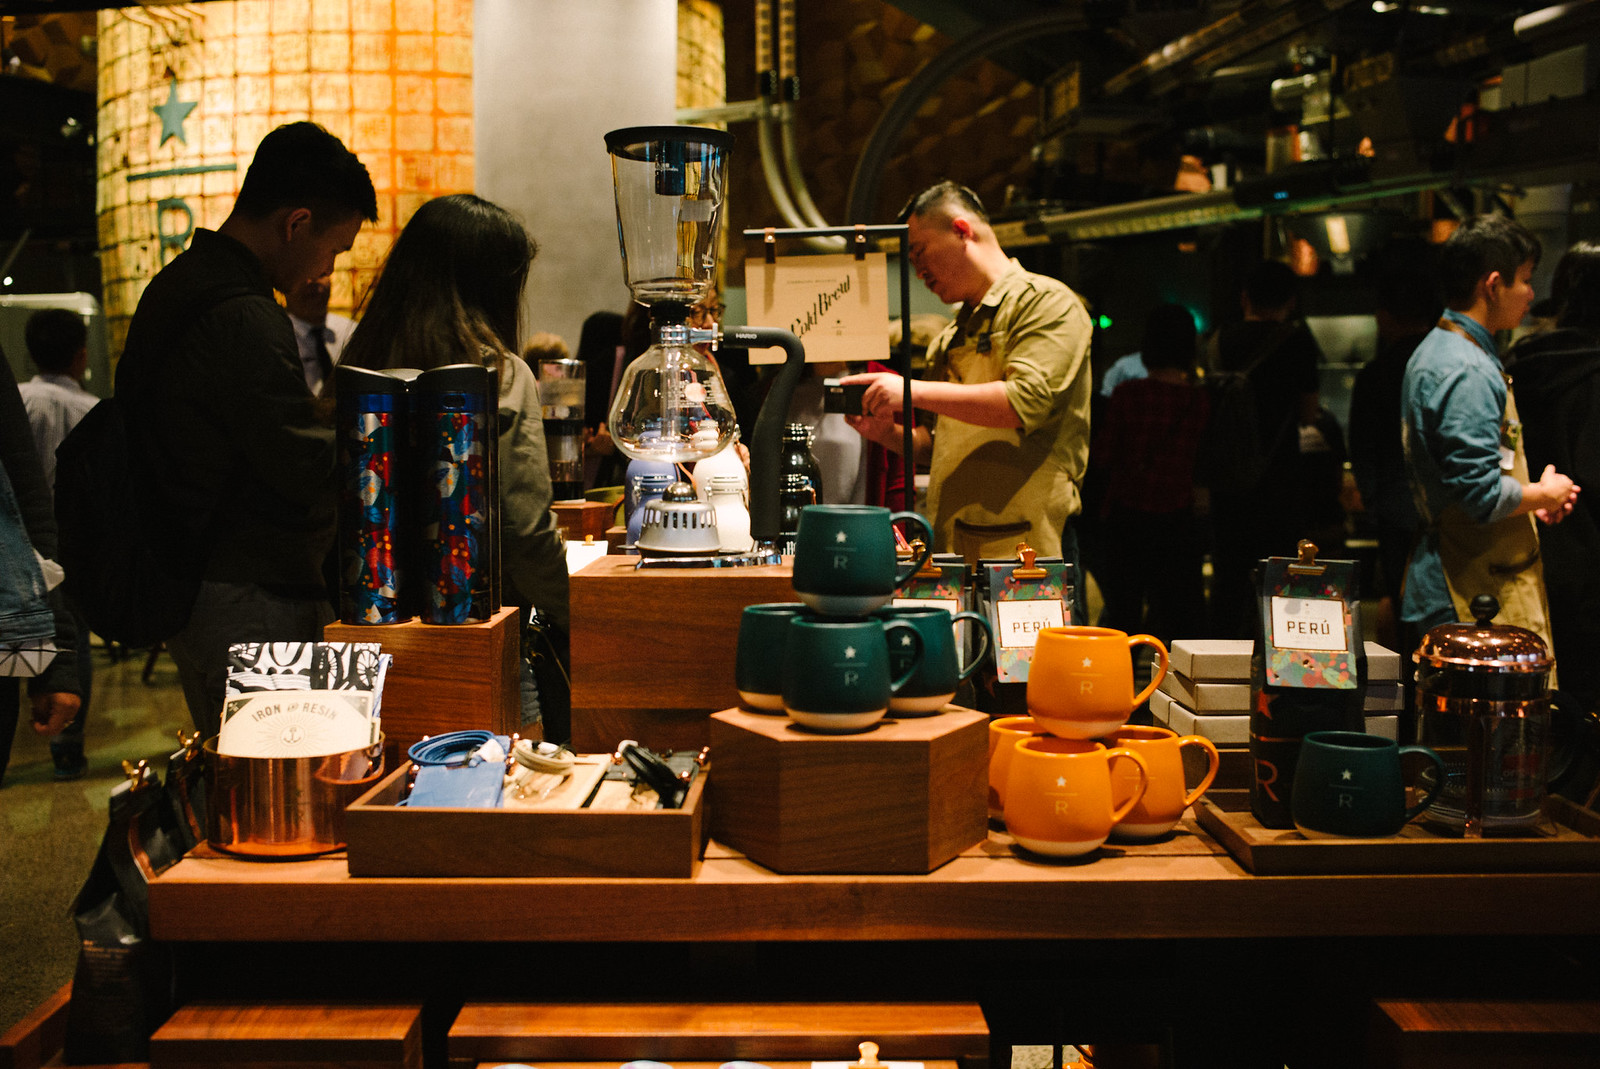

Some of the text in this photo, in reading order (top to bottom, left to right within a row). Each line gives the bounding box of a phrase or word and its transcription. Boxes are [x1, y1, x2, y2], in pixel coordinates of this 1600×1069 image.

[818, 274, 851, 316] Brew
[735, 332, 757, 340] HARIO
[833, 555, 848, 570] R
[1287, 619, 1330, 635] PERÚ
[844, 671, 859, 686] R
[1080, 680, 1093, 695] R
[251, 703, 282, 722] IRON
[302, 701, 339, 721] RESIN
[1255, 758, 1280, 802] R
[1055, 800, 1068, 815] R
[1339, 793, 1353, 808] R
